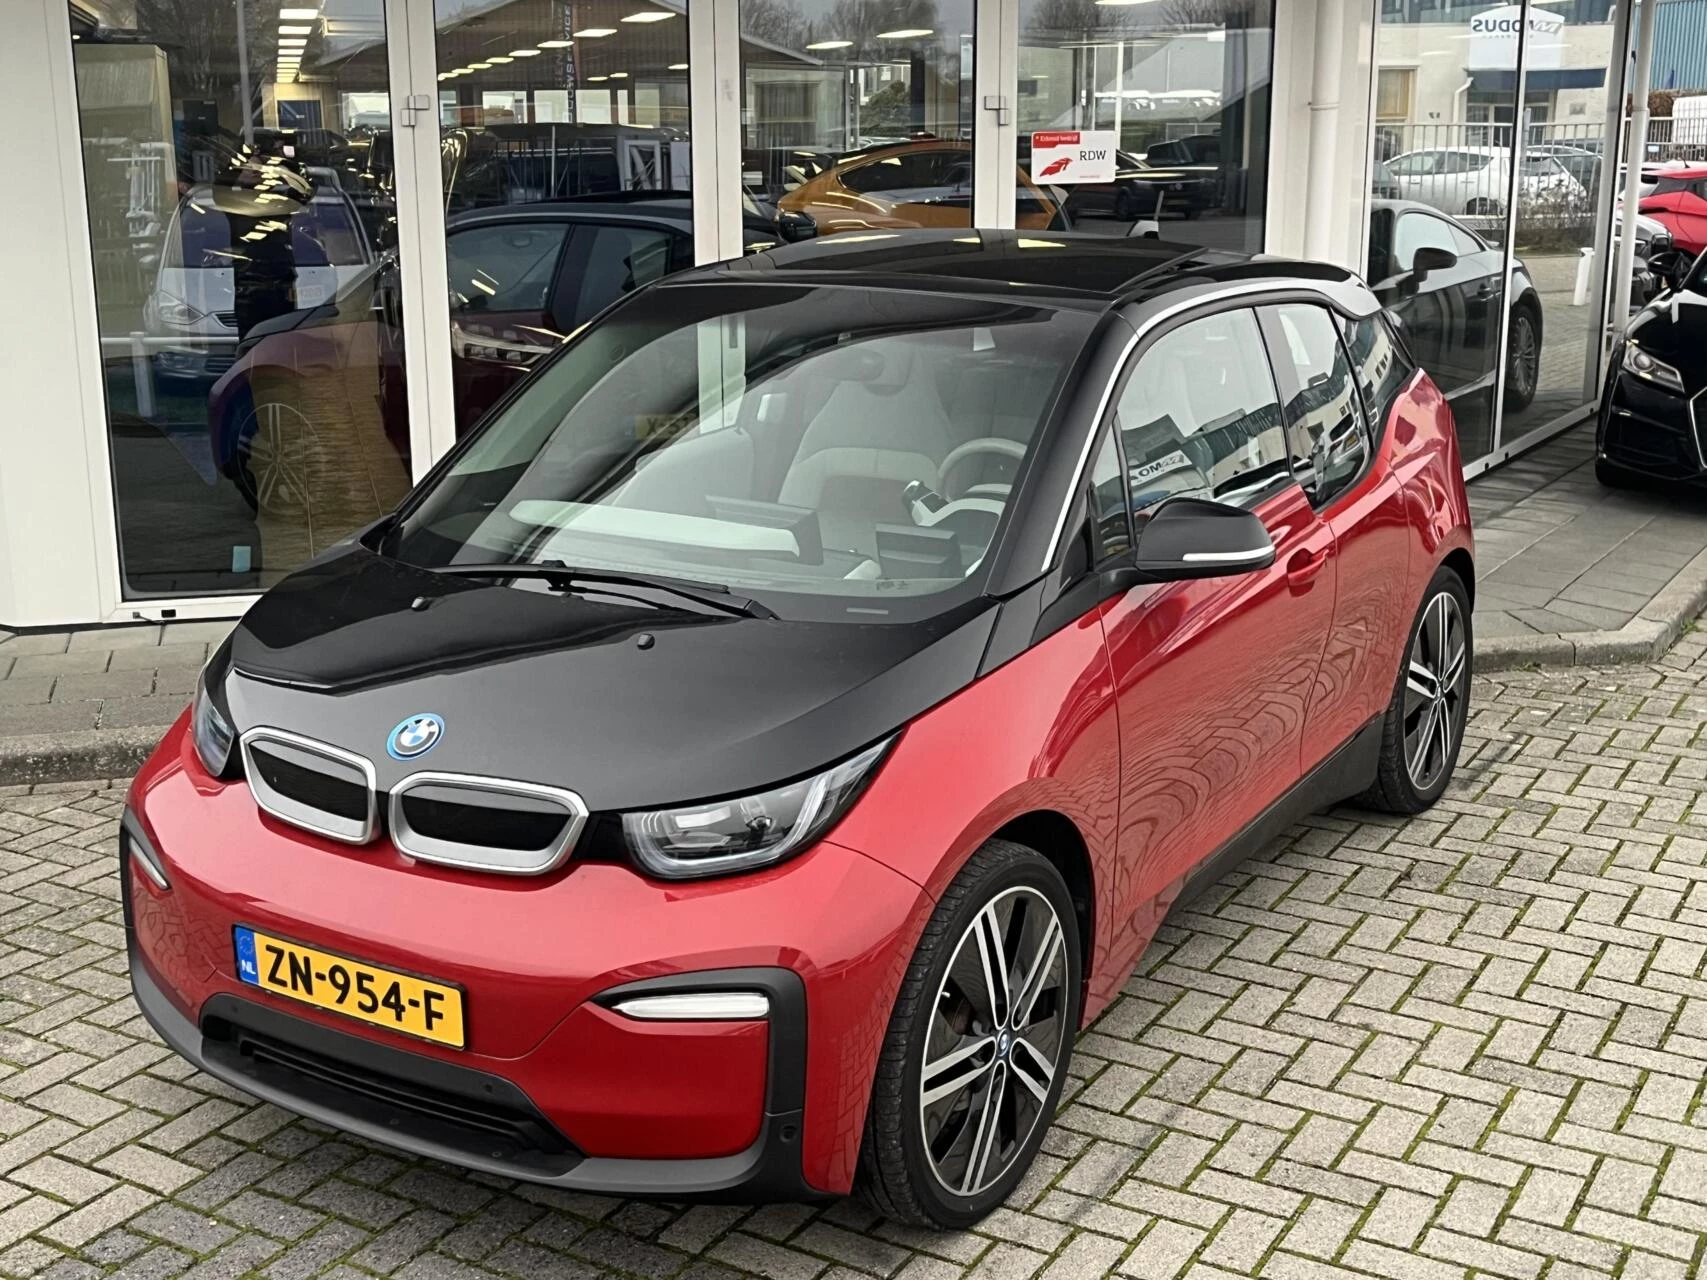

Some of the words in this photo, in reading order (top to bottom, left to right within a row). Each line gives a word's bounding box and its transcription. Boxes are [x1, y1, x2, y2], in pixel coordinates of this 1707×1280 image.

[1080, 150, 1106, 161] RDW
[241, 960, 256, 975] NL
[265, 944, 445, 1030] ZN-954-F
